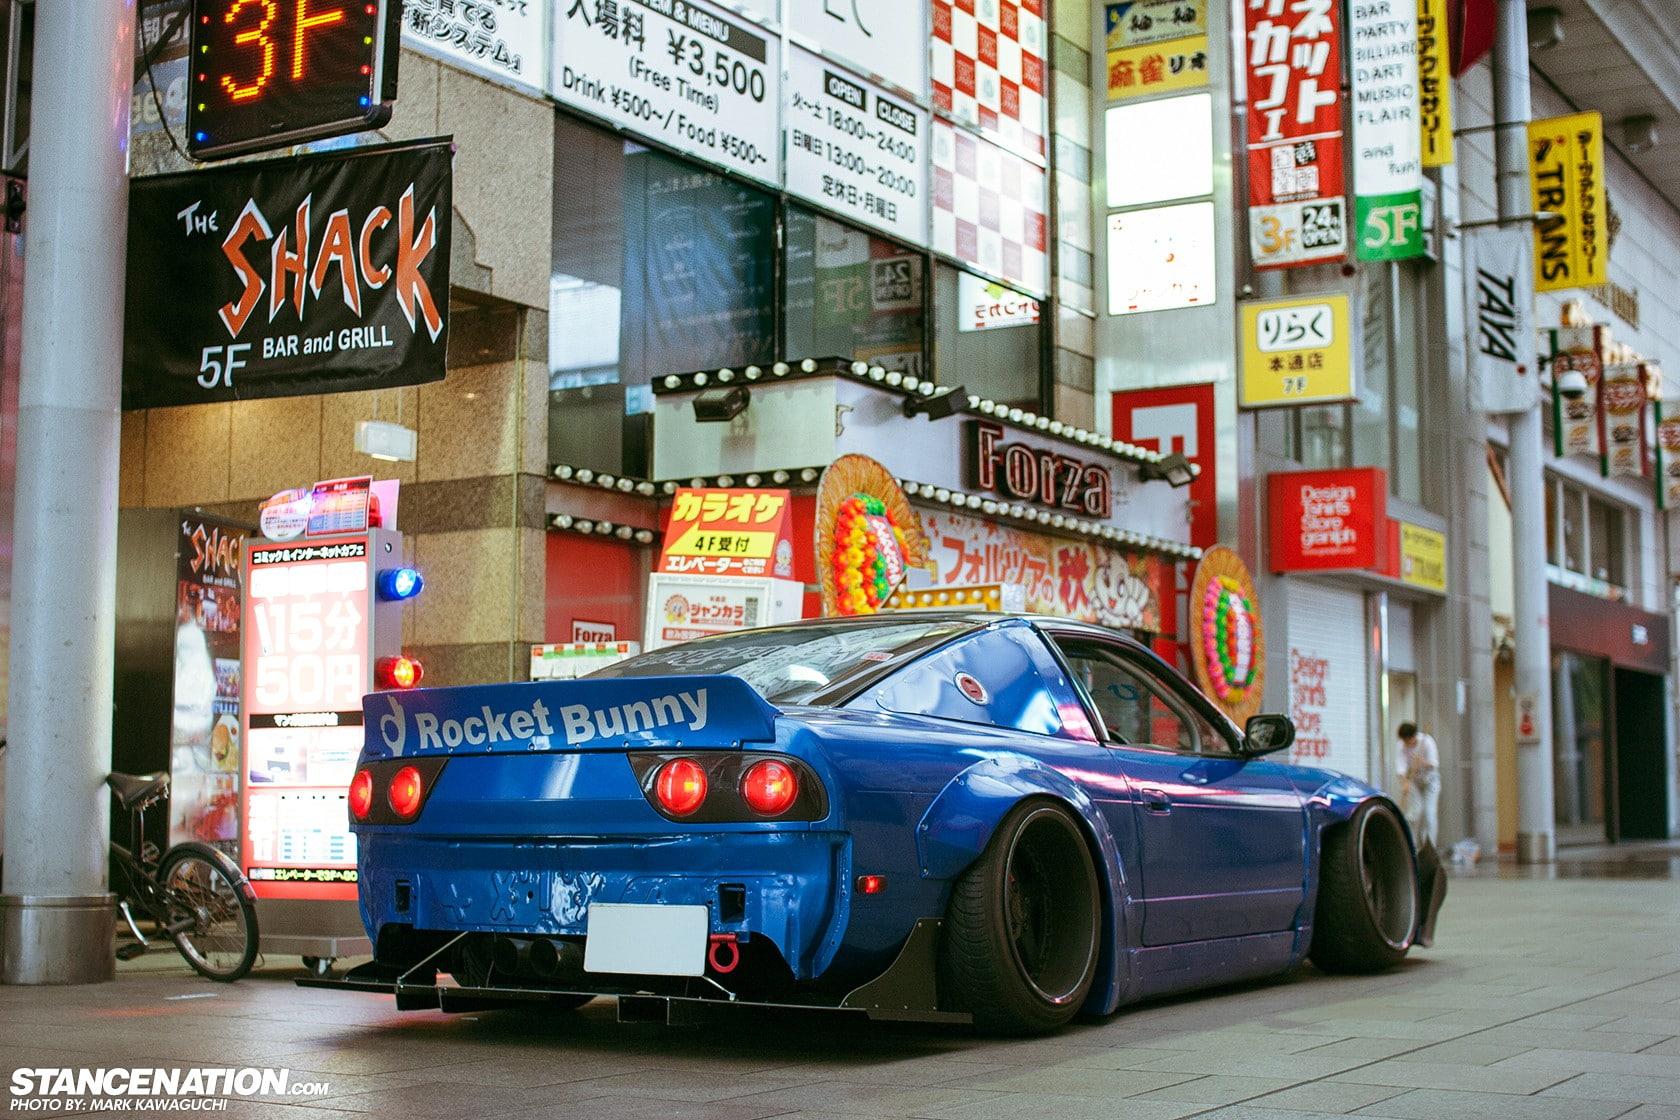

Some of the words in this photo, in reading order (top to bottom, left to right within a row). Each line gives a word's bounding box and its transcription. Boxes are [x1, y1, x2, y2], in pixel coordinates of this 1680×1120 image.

[567, 0, 645, 52] 入場料
[688, 8, 730, 42] MENU
[1354, 1, 1391, 20] BAR
[1355, 21, 1410, 41] PARTY
[667, 28, 766, 103] ¥3,500
[1356, 64, 1404, 84] DART
[629, 55, 672, 93] (Free
[676, 78, 719, 115] Time)
[828, 76, 863, 107] OPEN
[878, 101, 916, 131] CLOSE
[1357, 85, 1414, 104] MUSIC
[562, 64, 607, 105] Drink
[677, 114, 717, 148] Food
[1357, 107, 1412, 126] FLAIR
[792, 129, 822, 156] 日曜日
[1261, 215, 1296, 254] 3F
[1364, 204, 1419, 250] 5F
[1535, 161, 1570, 283] TRANS
[217, 182, 444, 344] SHACK
[1264, 310, 1326, 345] りらく
[1477, 266, 1518, 364] TAYA
[263, 332, 299, 361] BAR
[303, 330, 334, 355] and
[338, 324, 394, 352] GRILL
[197, 341, 252, 389] 5F
[977, 423, 1113, 519] Forza
[672, 492, 785, 523] カラオケ
[1301, 483, 1357, 502] Design
[1301, 515, 1344, 532] Store
[690, 602, 744, 619] ジャンカラ
[574, 627, 613, 643] Forza
[255, 653, 361, 707] 50円
[414, 697, 555, 750] Rocket
[559, 687, 709, 745] Bunny
